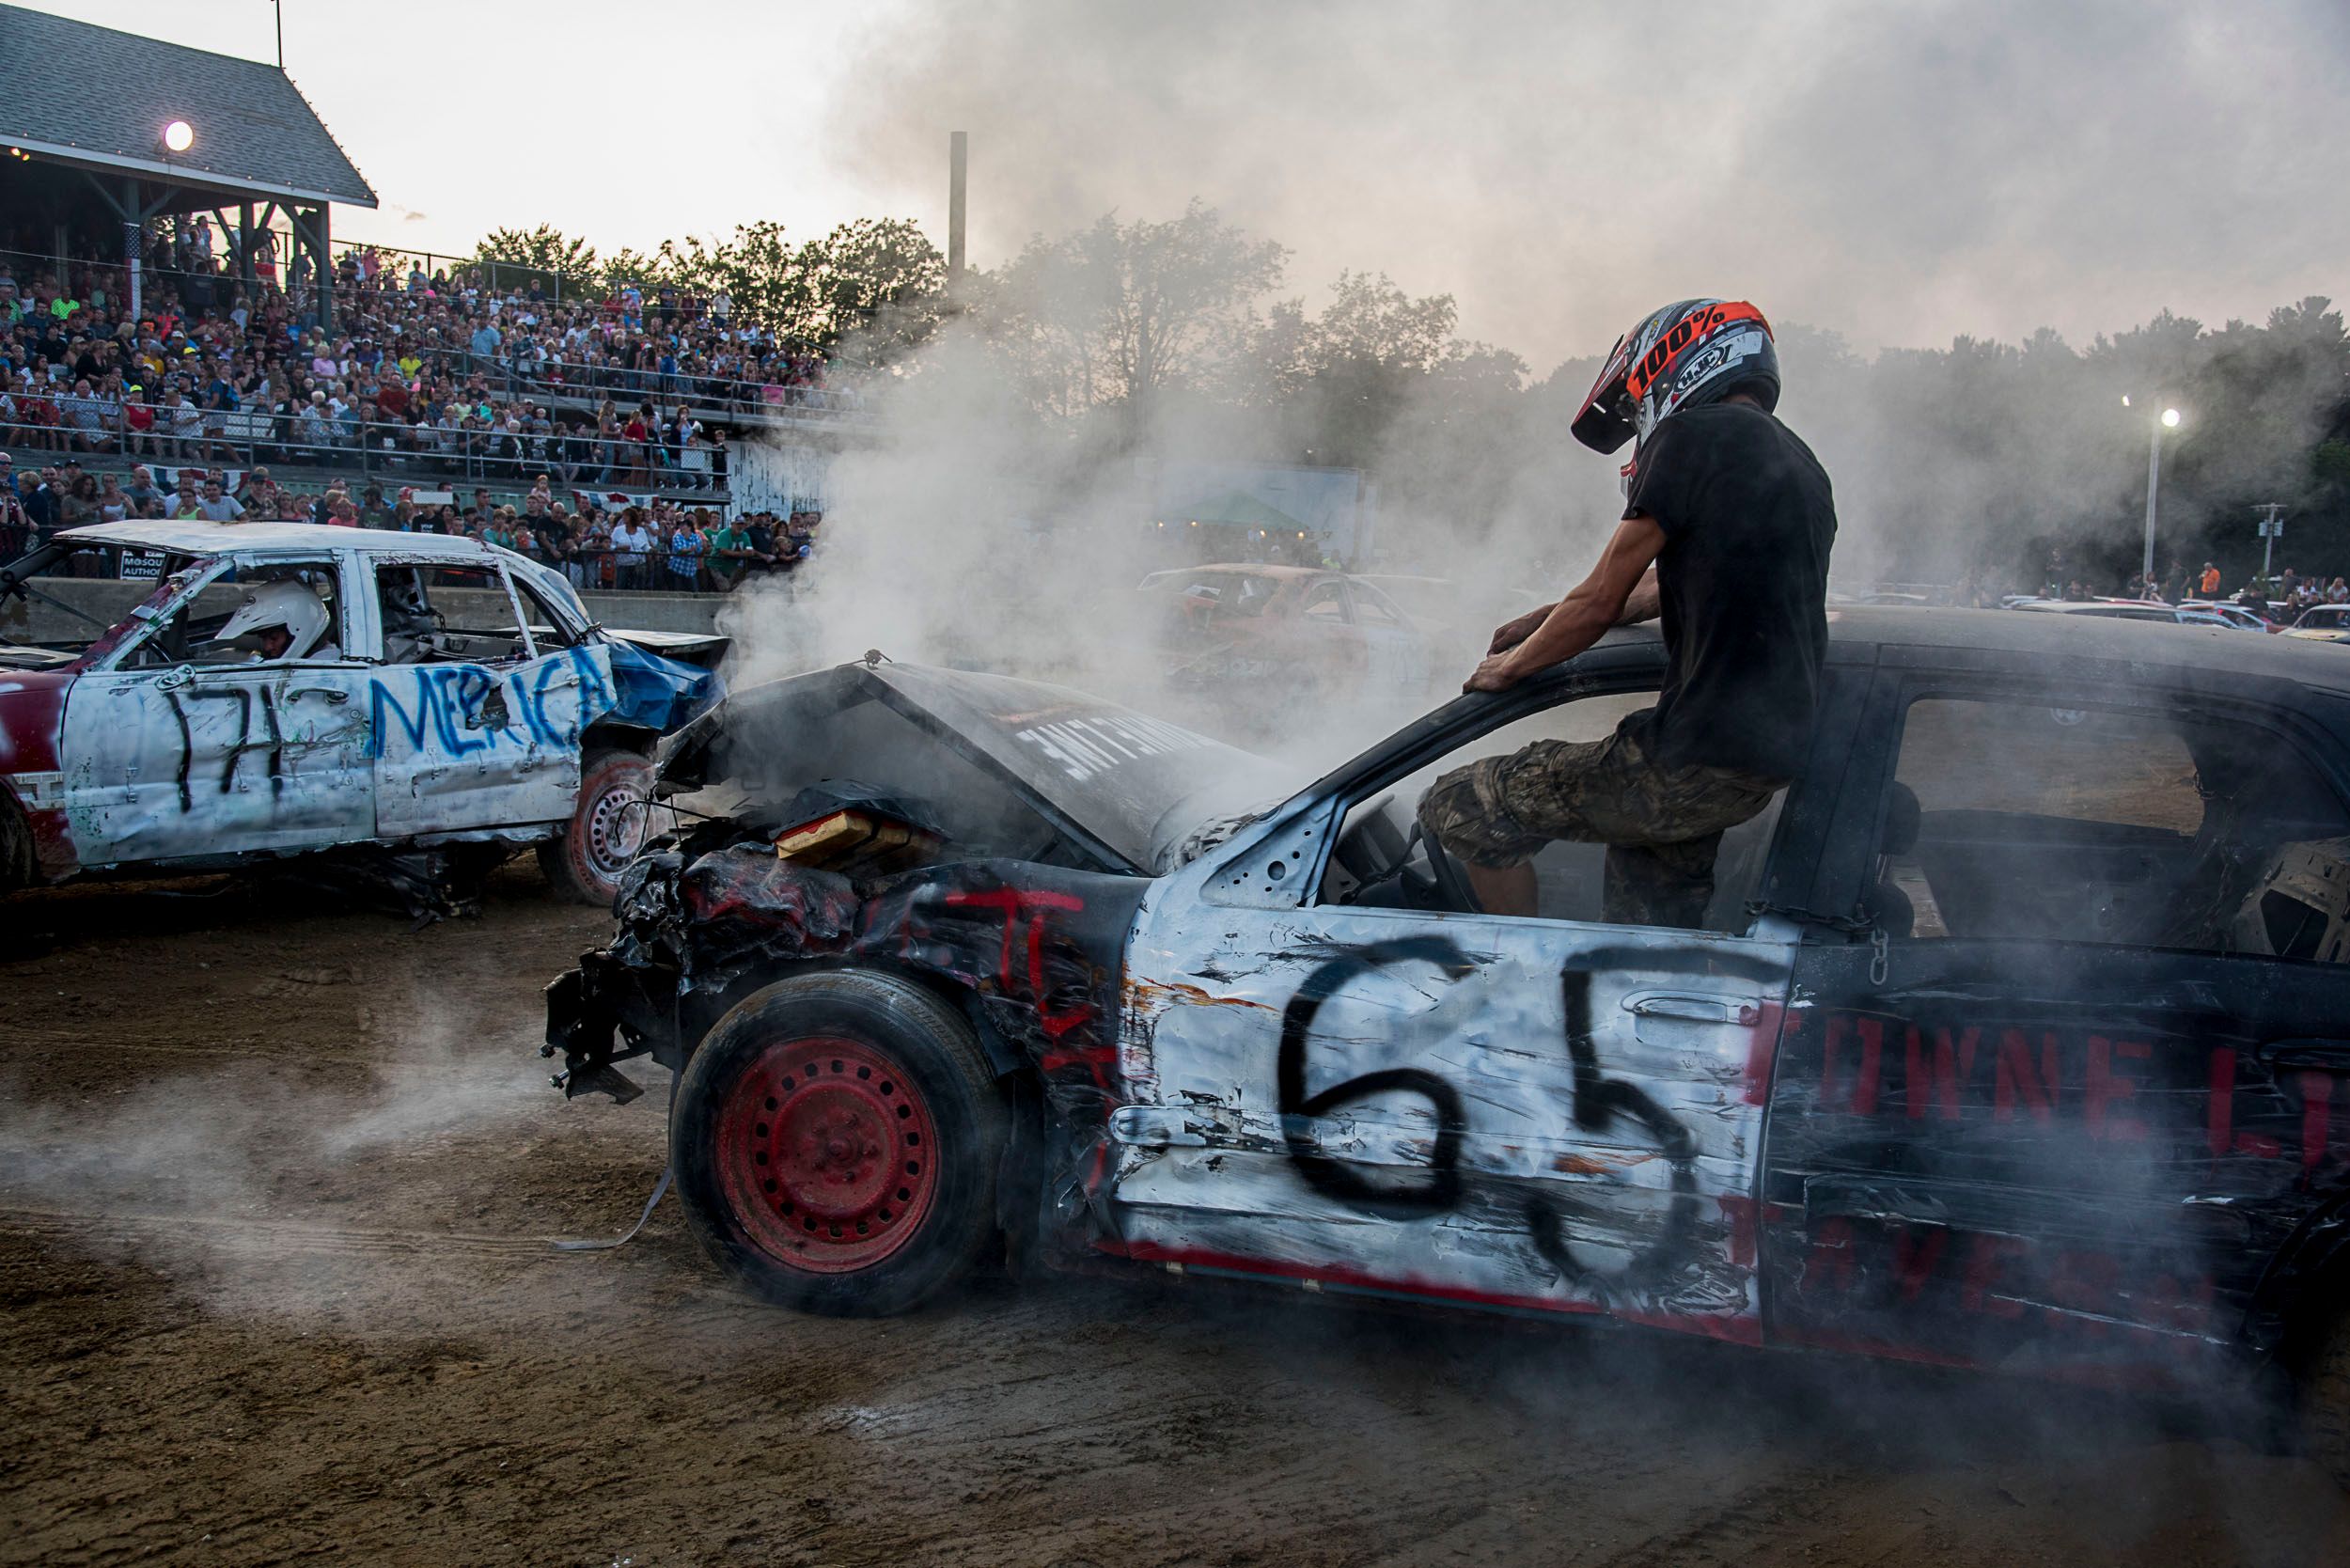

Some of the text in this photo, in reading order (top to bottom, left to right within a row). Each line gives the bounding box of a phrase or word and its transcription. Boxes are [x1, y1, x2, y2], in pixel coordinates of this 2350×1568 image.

[1633, 306, 1726, 392] 100%
[1677, 352, 1717, 387] HJC
[1277, 933, 1791, 1301] 65
